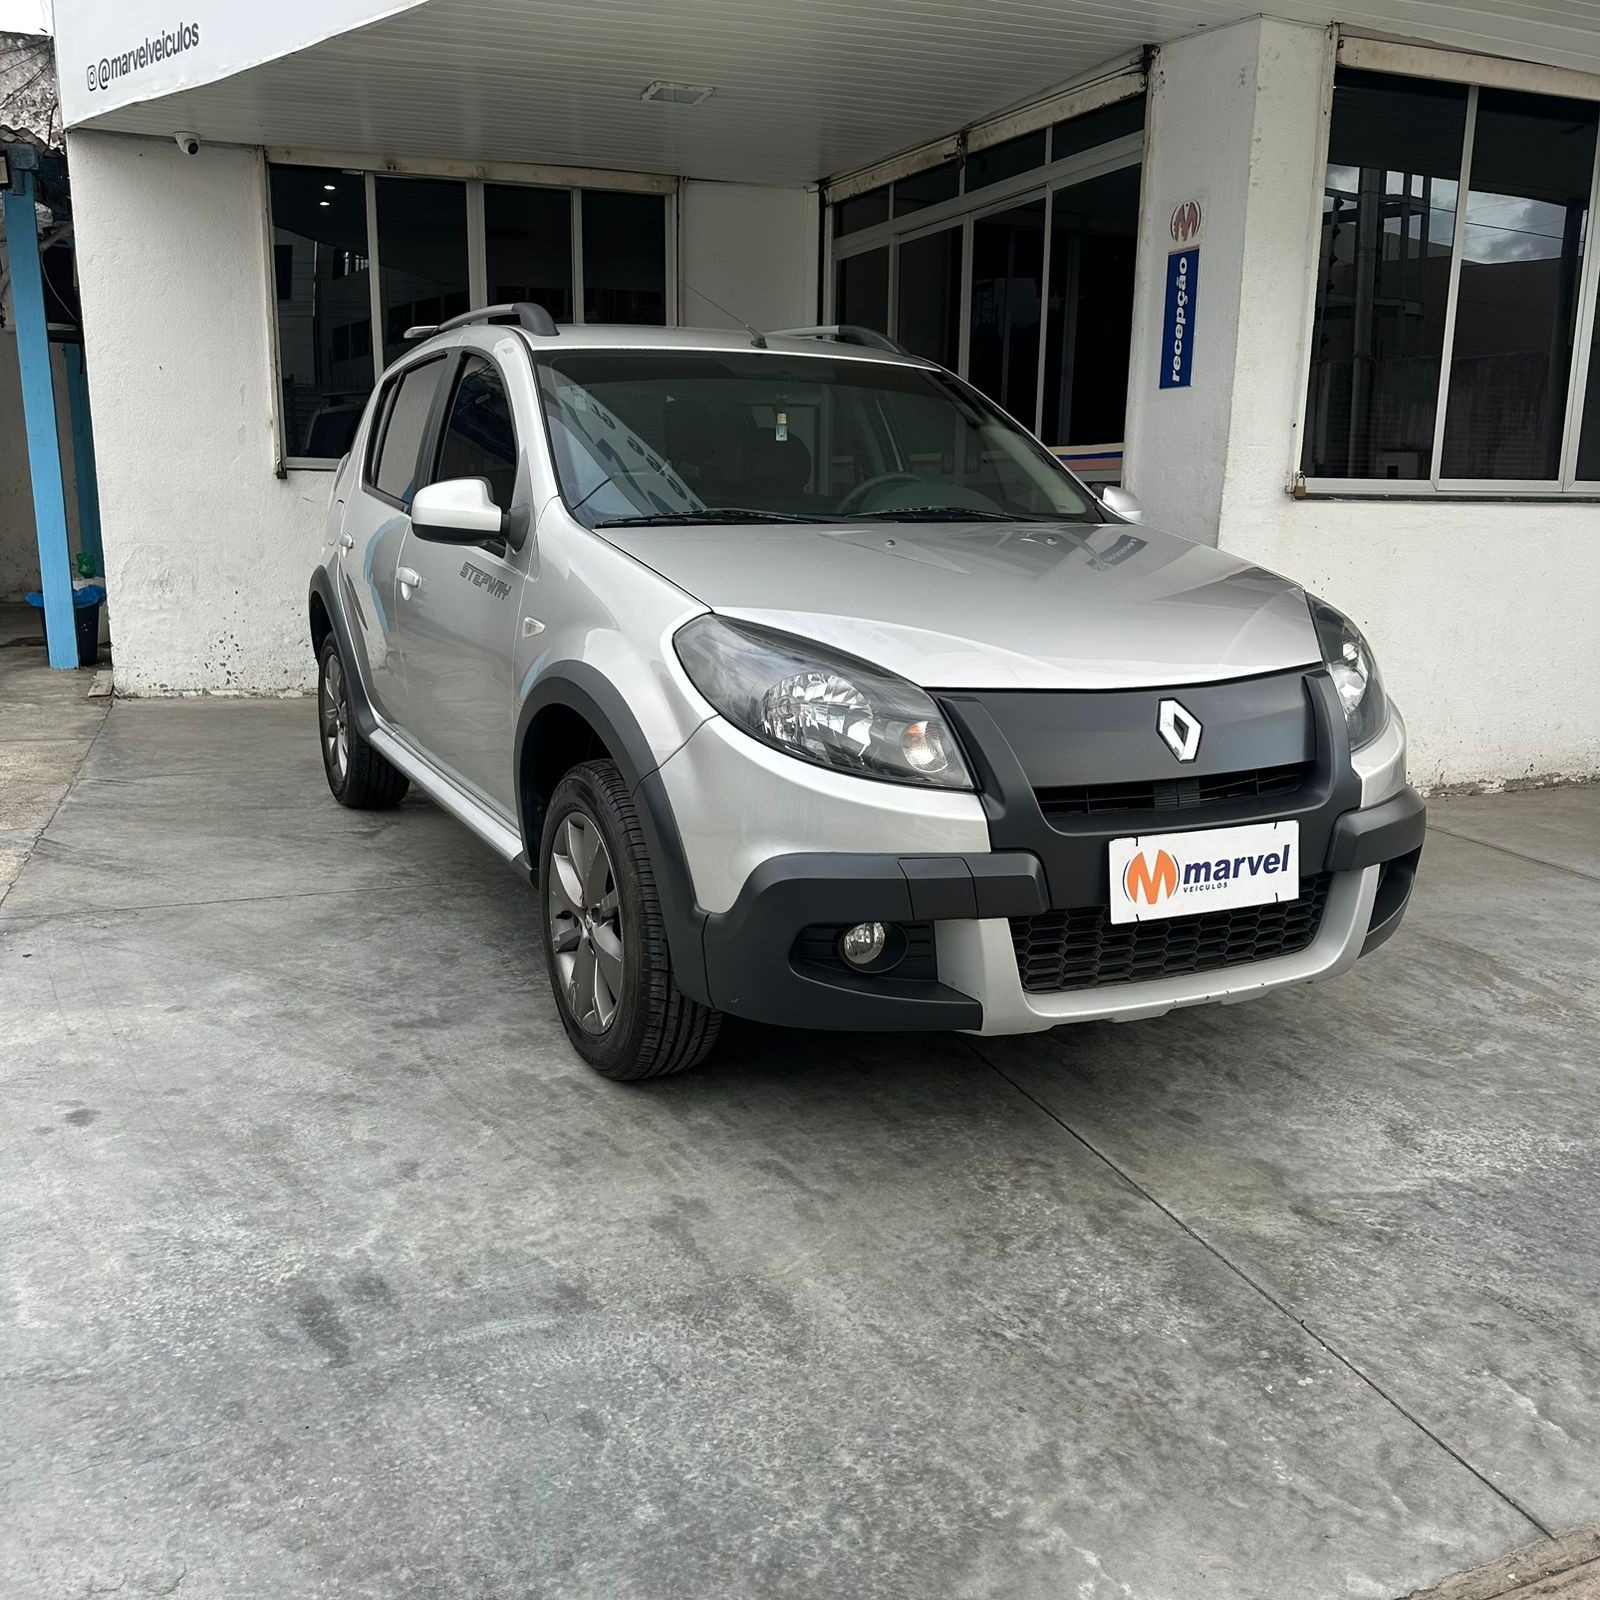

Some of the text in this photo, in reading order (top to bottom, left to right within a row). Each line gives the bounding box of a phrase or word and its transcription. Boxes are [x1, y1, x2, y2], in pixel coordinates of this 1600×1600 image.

[1172, 257, 1188, 382] recepção
[460, 561, 512, 600] STEPWAY
[1183, 844, 1290, 885] marvel
